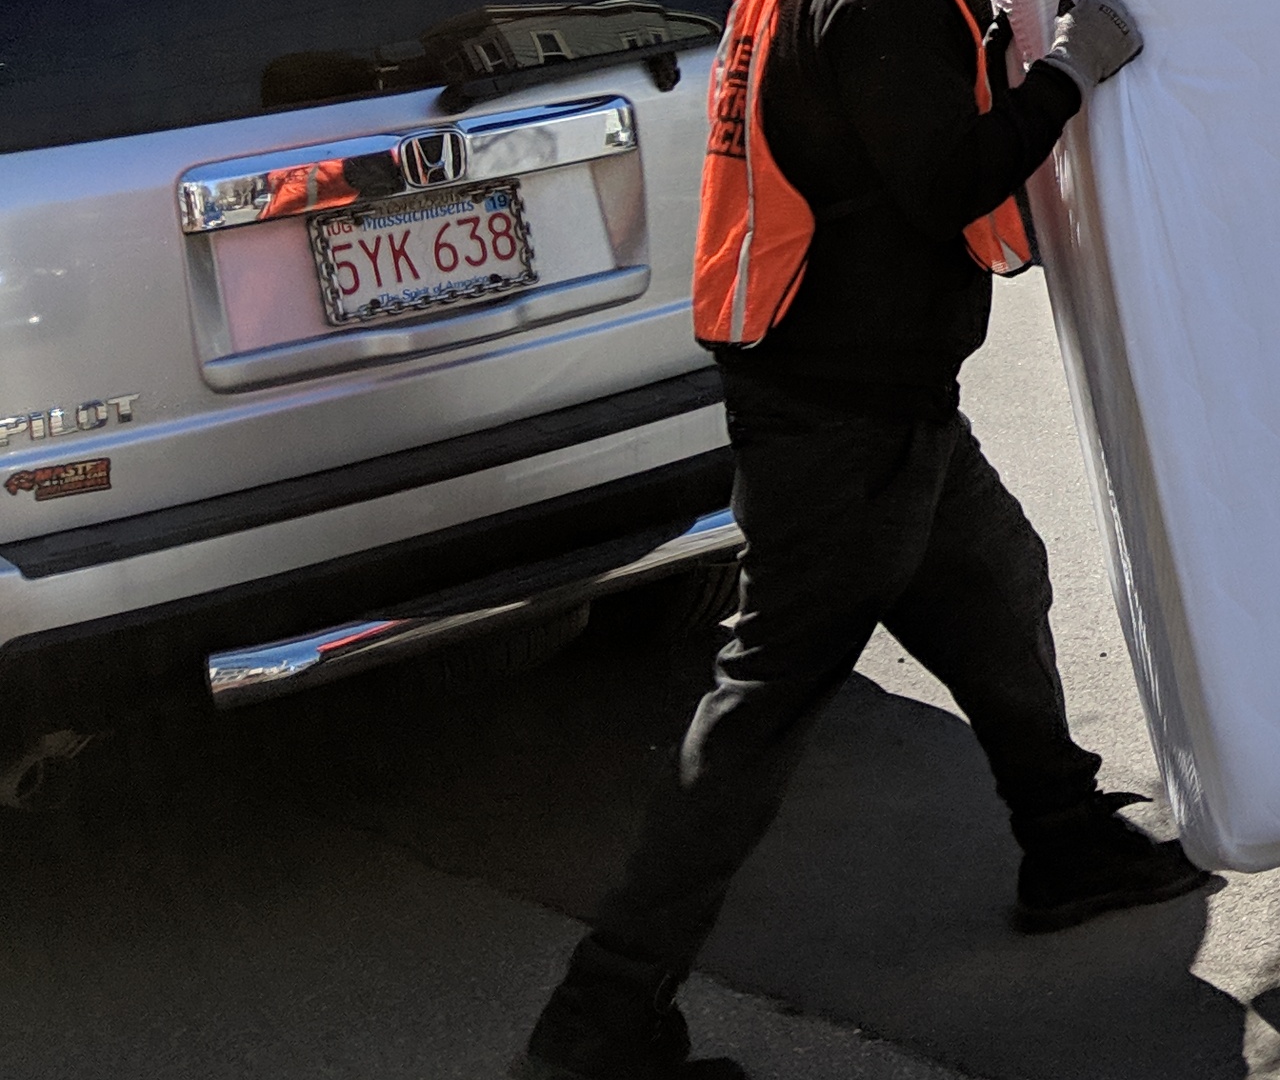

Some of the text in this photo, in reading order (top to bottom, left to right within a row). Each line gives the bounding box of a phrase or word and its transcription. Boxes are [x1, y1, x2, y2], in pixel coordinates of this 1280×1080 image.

[362, 200, 474, 232] Massachusetts
[490, 194, 508, 210] 19
[331, 212, 518, 296] 5YK 638
[0, 392, 140, 447] PILOT
